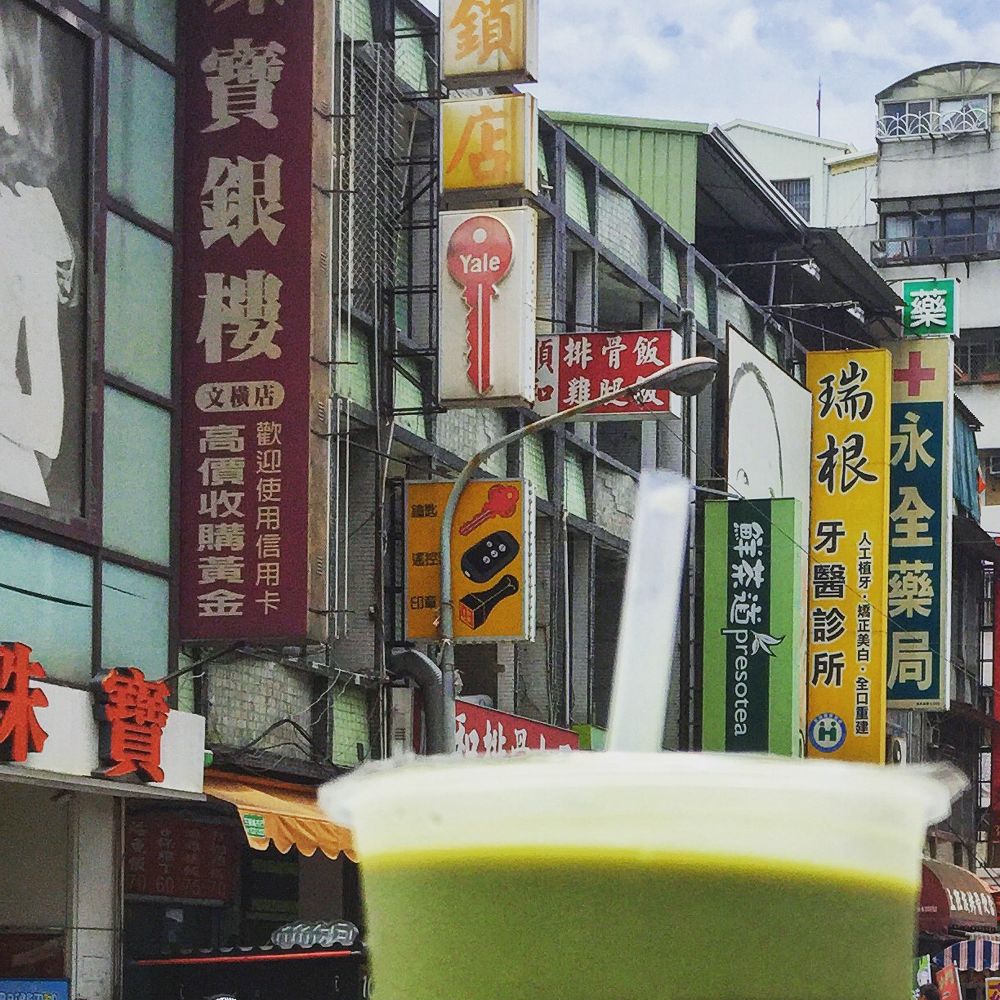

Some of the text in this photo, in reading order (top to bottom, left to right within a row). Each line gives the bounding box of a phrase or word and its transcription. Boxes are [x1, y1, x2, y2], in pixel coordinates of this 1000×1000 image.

[197, 0, 286, 363] 寶銀樓
[460, 254, 501, 274] Yale
[910, 289, 947, 328] 藥
[206, 385, 275, 409] 文橫店
[563, 335, 665, 370] 排骨飯
[817, 361, 878, 496] 瑞根
[197, 424, 246, 617] 高價收購黃金
[255, 421, 282, 615] 歡迎使用信用卡
[730, 522, 765, 624] 鮮茶道
[888, 411, 936, 691] 永全藥局
[811, 521, 847, 688] 牙醫診所
[721, 628, 751, 736] presotea
